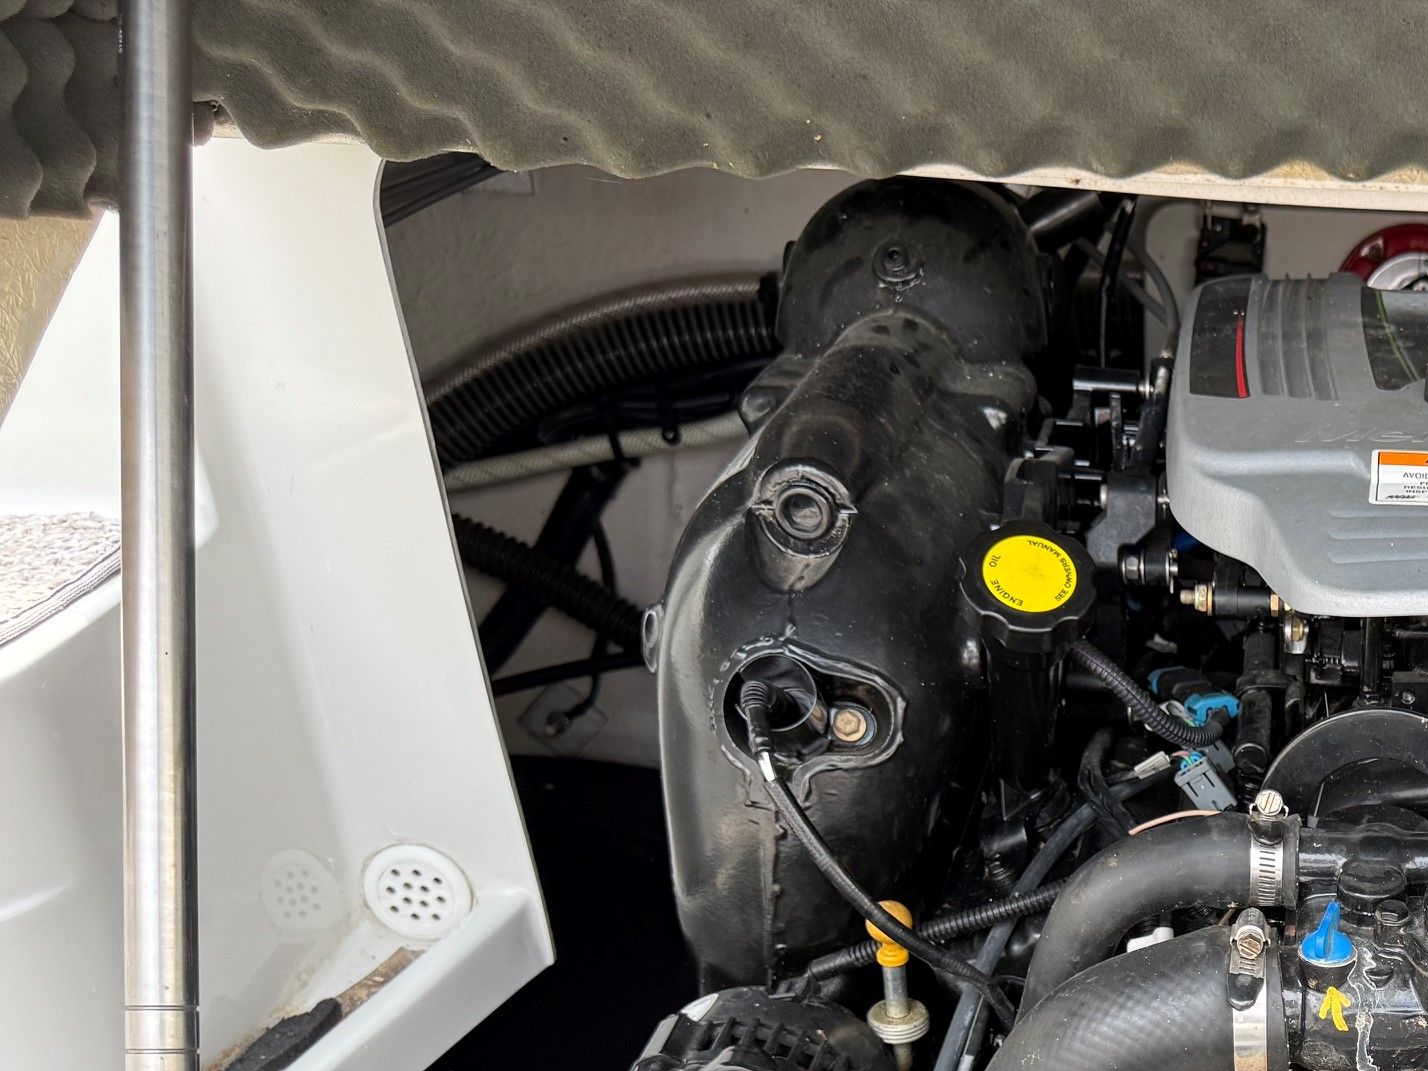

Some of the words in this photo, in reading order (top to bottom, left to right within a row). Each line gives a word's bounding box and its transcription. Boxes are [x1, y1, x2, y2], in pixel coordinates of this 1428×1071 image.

[1027, 539, 1062, 558] MANUAL
[989, 554, 1002, 568] OIL
[1059, 557, 1072, 589] OWNERS
[990, 579, 1024, 607] ENGINE
[1054, 588, 1068, 602] SEE
